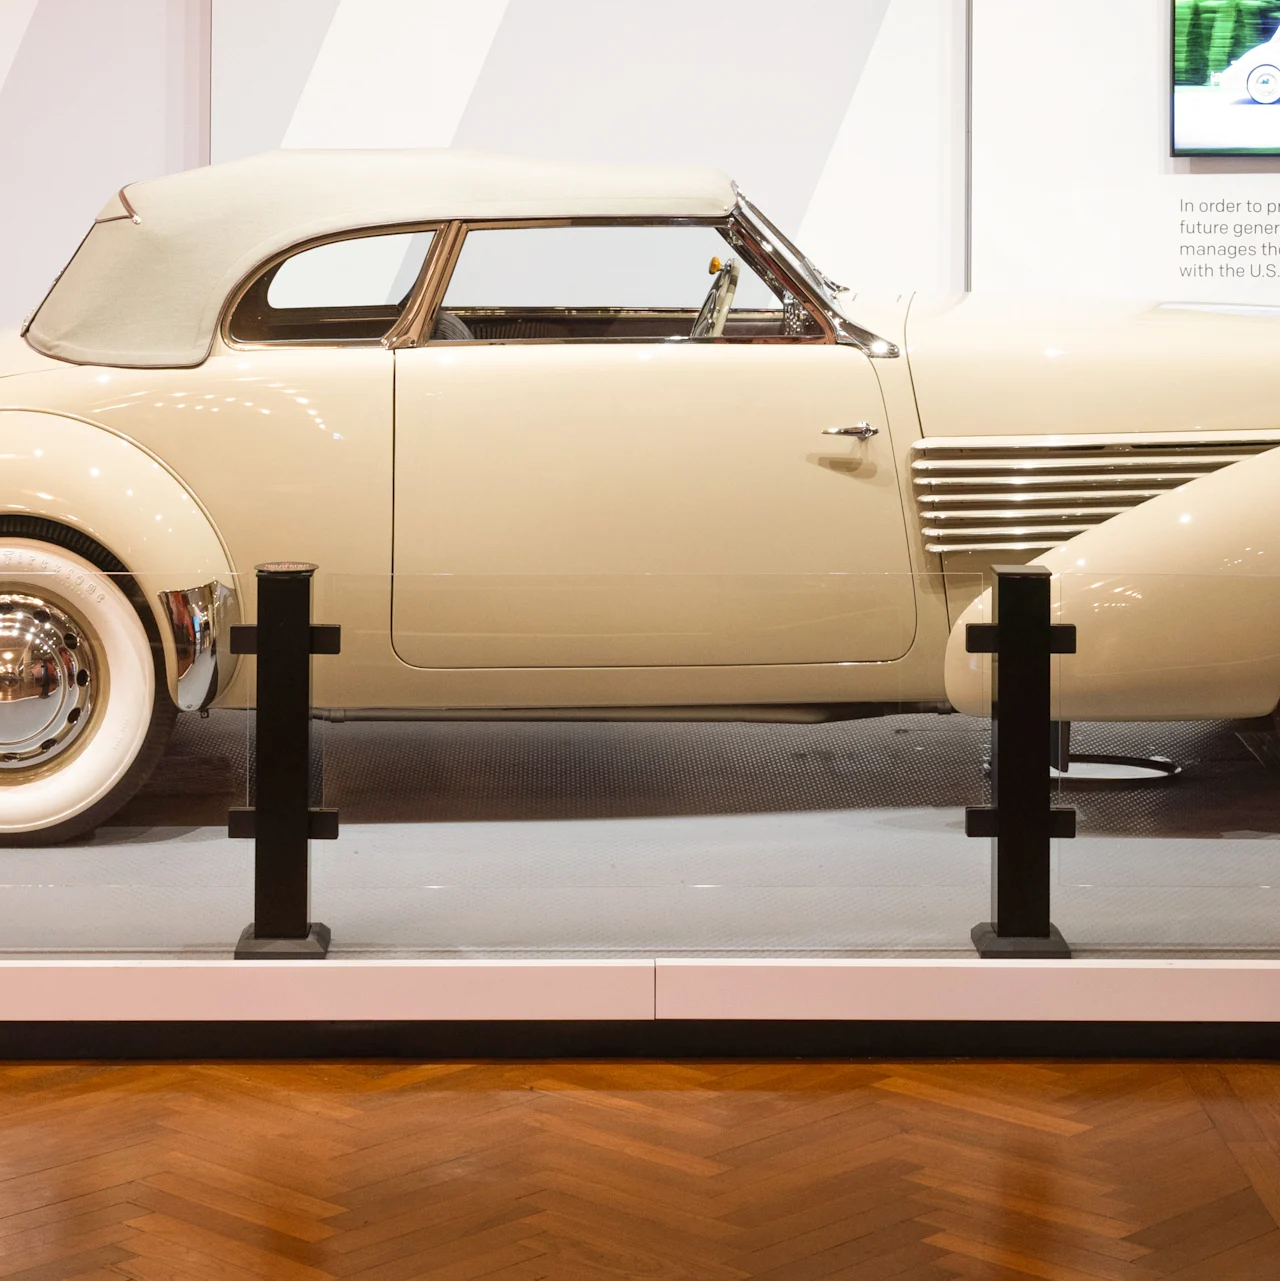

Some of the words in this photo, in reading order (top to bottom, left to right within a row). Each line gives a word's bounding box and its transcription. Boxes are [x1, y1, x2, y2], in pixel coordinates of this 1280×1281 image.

[1179, 199, 1195, 213] In
[1199, 198, 1242, 214] order
[1246, 200, 1262, 214] to
[1179, 219, 1229, 236] future
[1179, 245, 1257, 261] manages
[1179, 263, 1214, 278] with
[1218, 263, 1245, 278] the
[1249, 263, 1280, 279] U.S.
